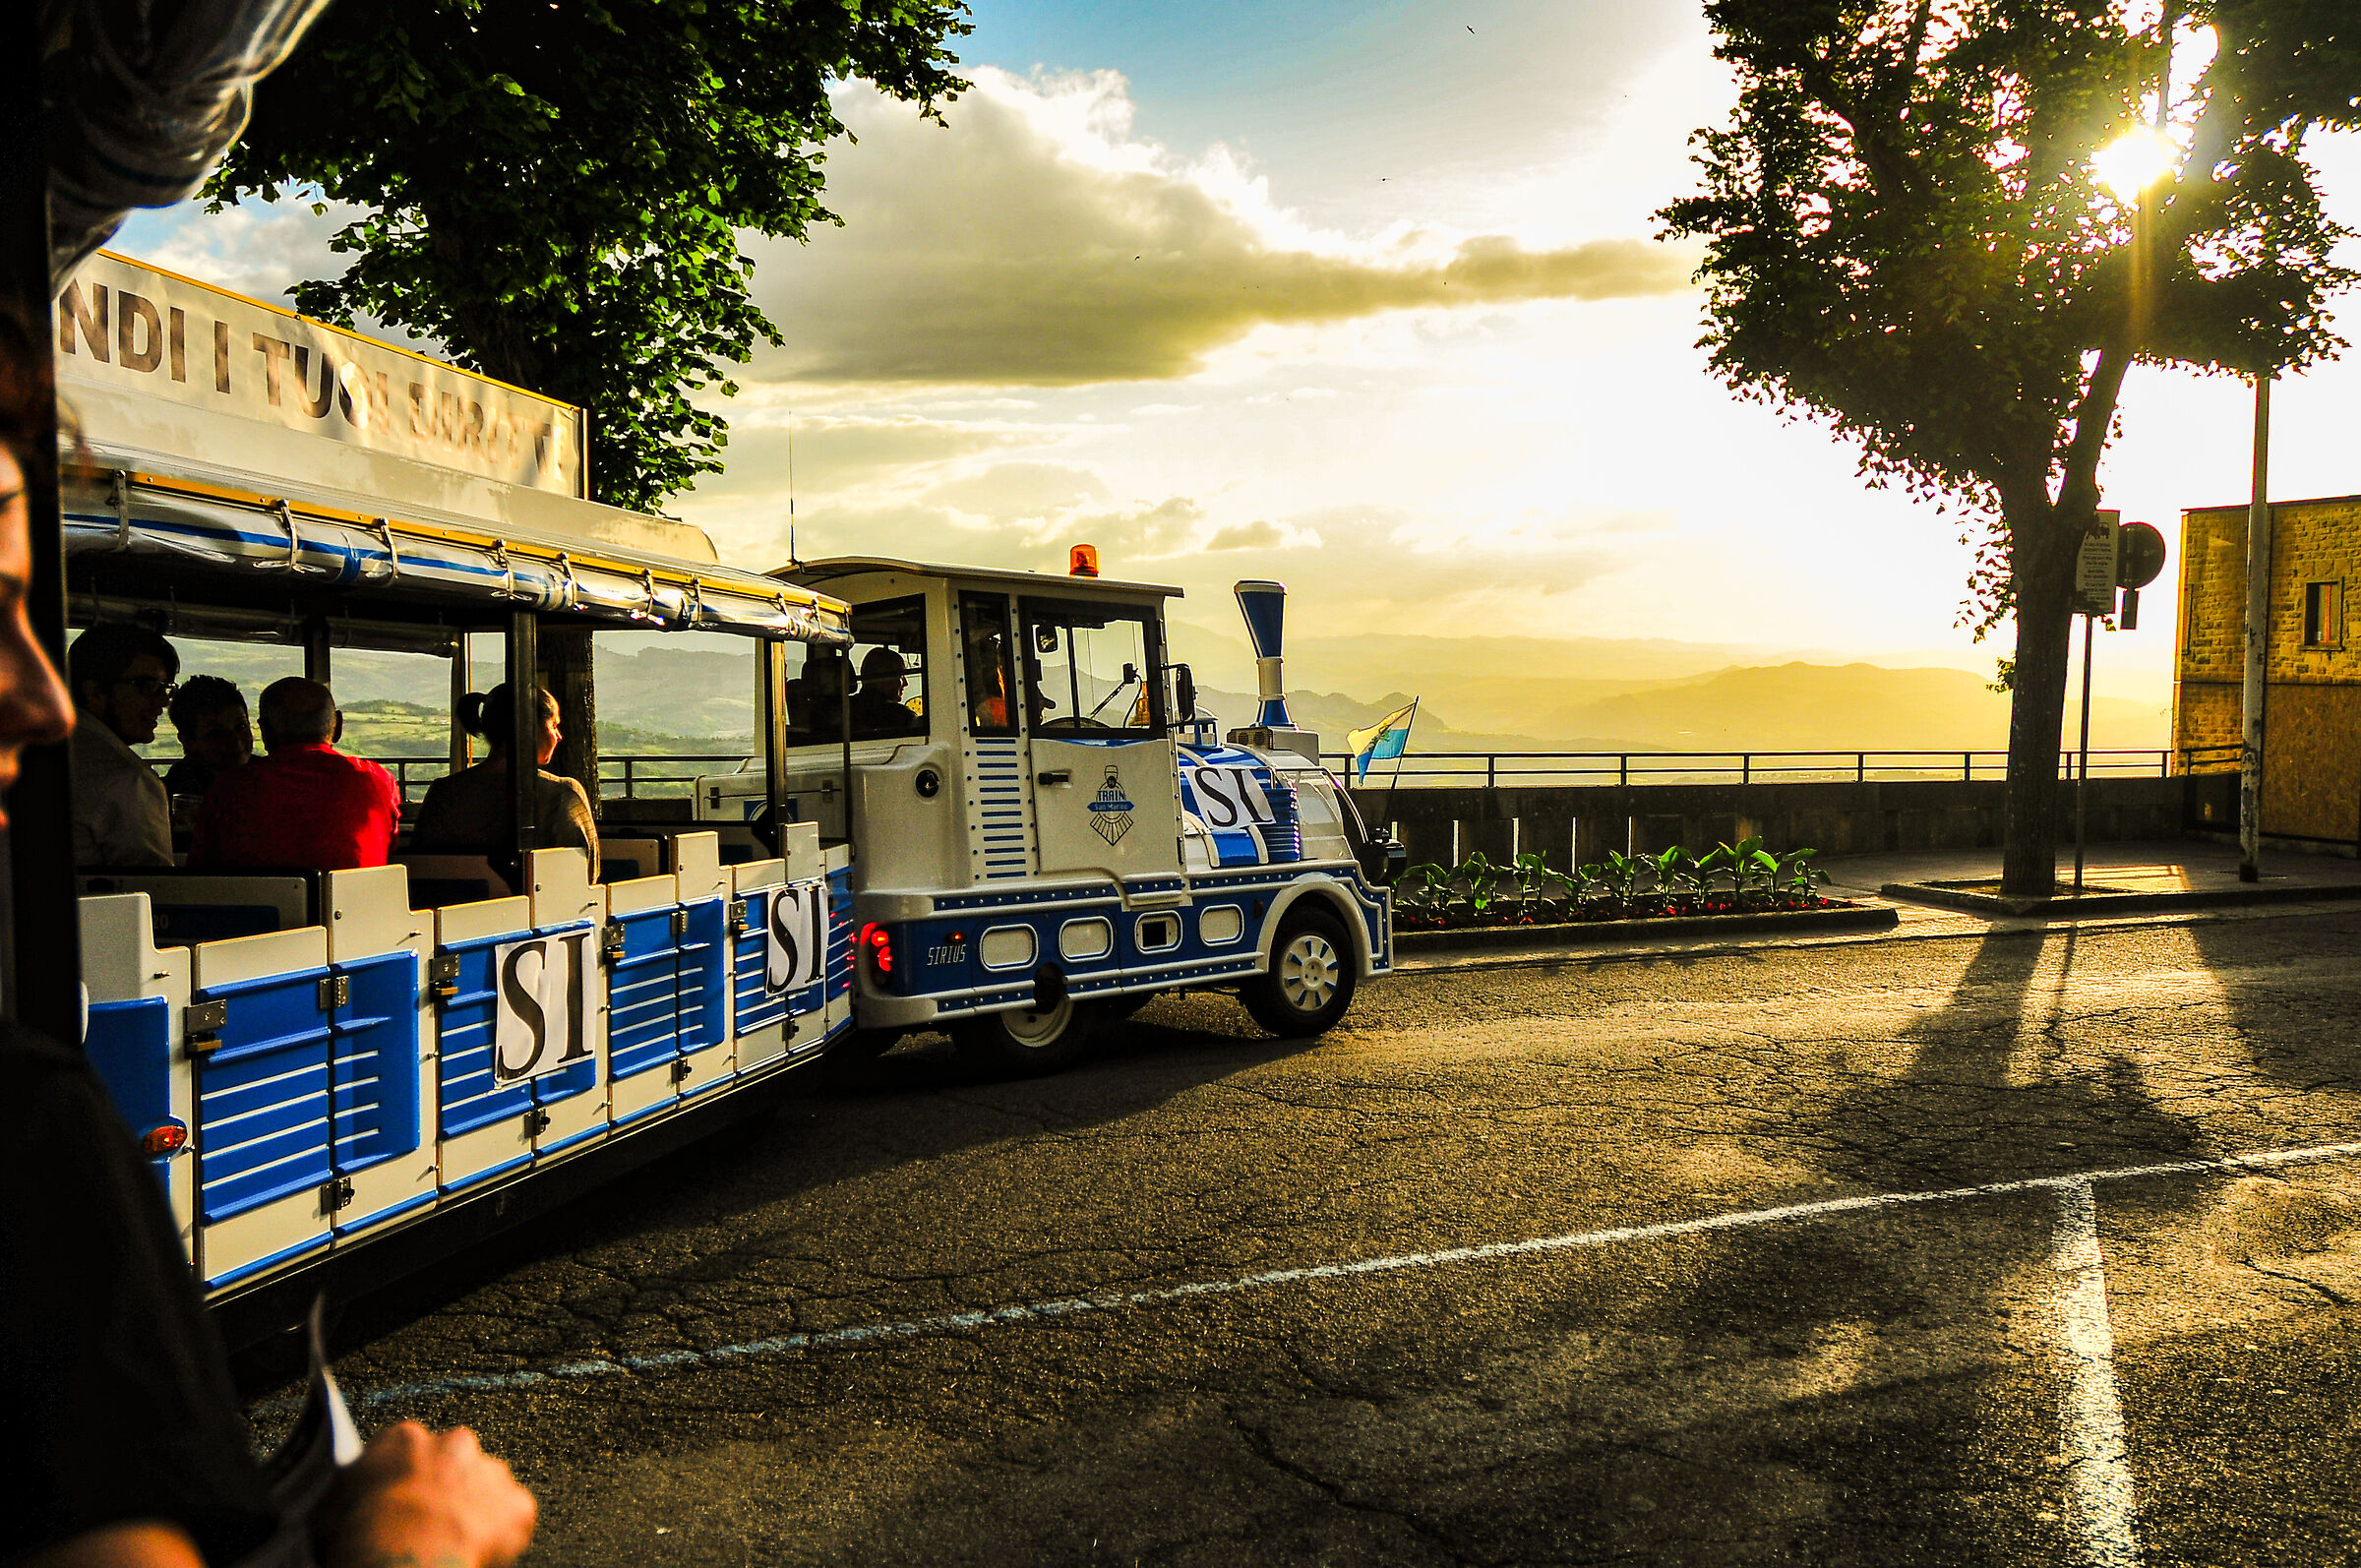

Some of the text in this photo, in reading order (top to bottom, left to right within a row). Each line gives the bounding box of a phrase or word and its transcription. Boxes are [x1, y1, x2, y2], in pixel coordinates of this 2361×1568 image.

[214, 321, 230, 393] I
[253, 332, 387, 436] TUOI
[408, 381, 564, 481] DIRITT
[1097, 790, 1125, 802] TRAIN
[1194, 767, 1273, 827] SI
[770, 885, 823, 994] SI
[927, 944, 966, 965] SIRIUS
[498, 933, 593, 1080] SI
